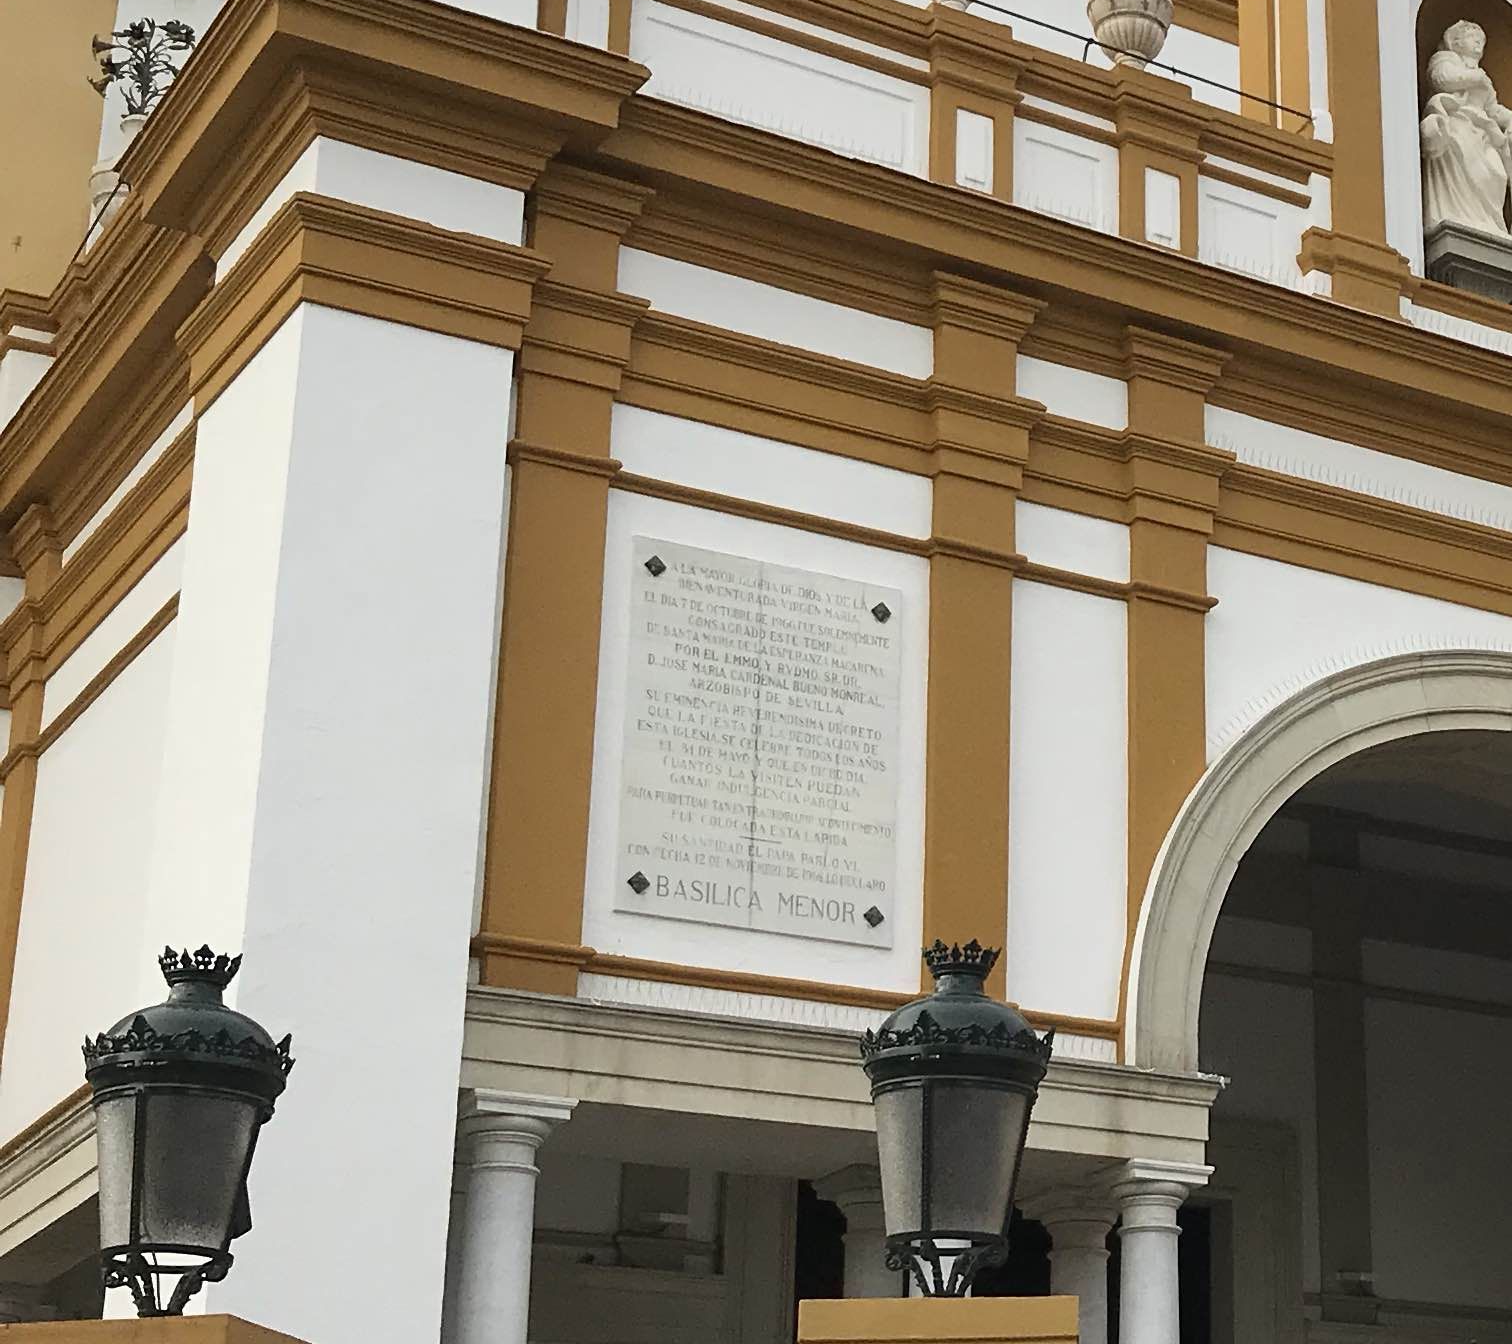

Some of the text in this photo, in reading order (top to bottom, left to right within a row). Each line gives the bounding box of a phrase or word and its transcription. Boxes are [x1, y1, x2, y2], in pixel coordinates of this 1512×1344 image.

[689, 598, 704, 613] DE
[674, 642, 700, 659] POR
[703, 648, 720, 662] EL
[764, 659, 771, 672] Y
[691, 660, 727, 679] MARIA
[729, 667, 790, 690] CARDENAL
[792, 679, 828, 697] BUENO
[688, 676, 845, 715] ARZOBISPO DE SEVILLA
[636, 718, 669, 736] ESTA
[720, 732, 736, 747] SE
[795, 744, 833, 763] TODOS
[834, 751, 854, 767] LOS
[647, 704, 669, 720] QUE
[677, 709, 696, 724] LA
[862, 741, 879, 755] DE
[697, 744, 713, 759] DE
[766, 756, 789, 771] QUE
[727, 765, 745, 780] LA
[748, 844, 761, 858] EL
[655, 874, 855, 924] BASILICA MENOR
